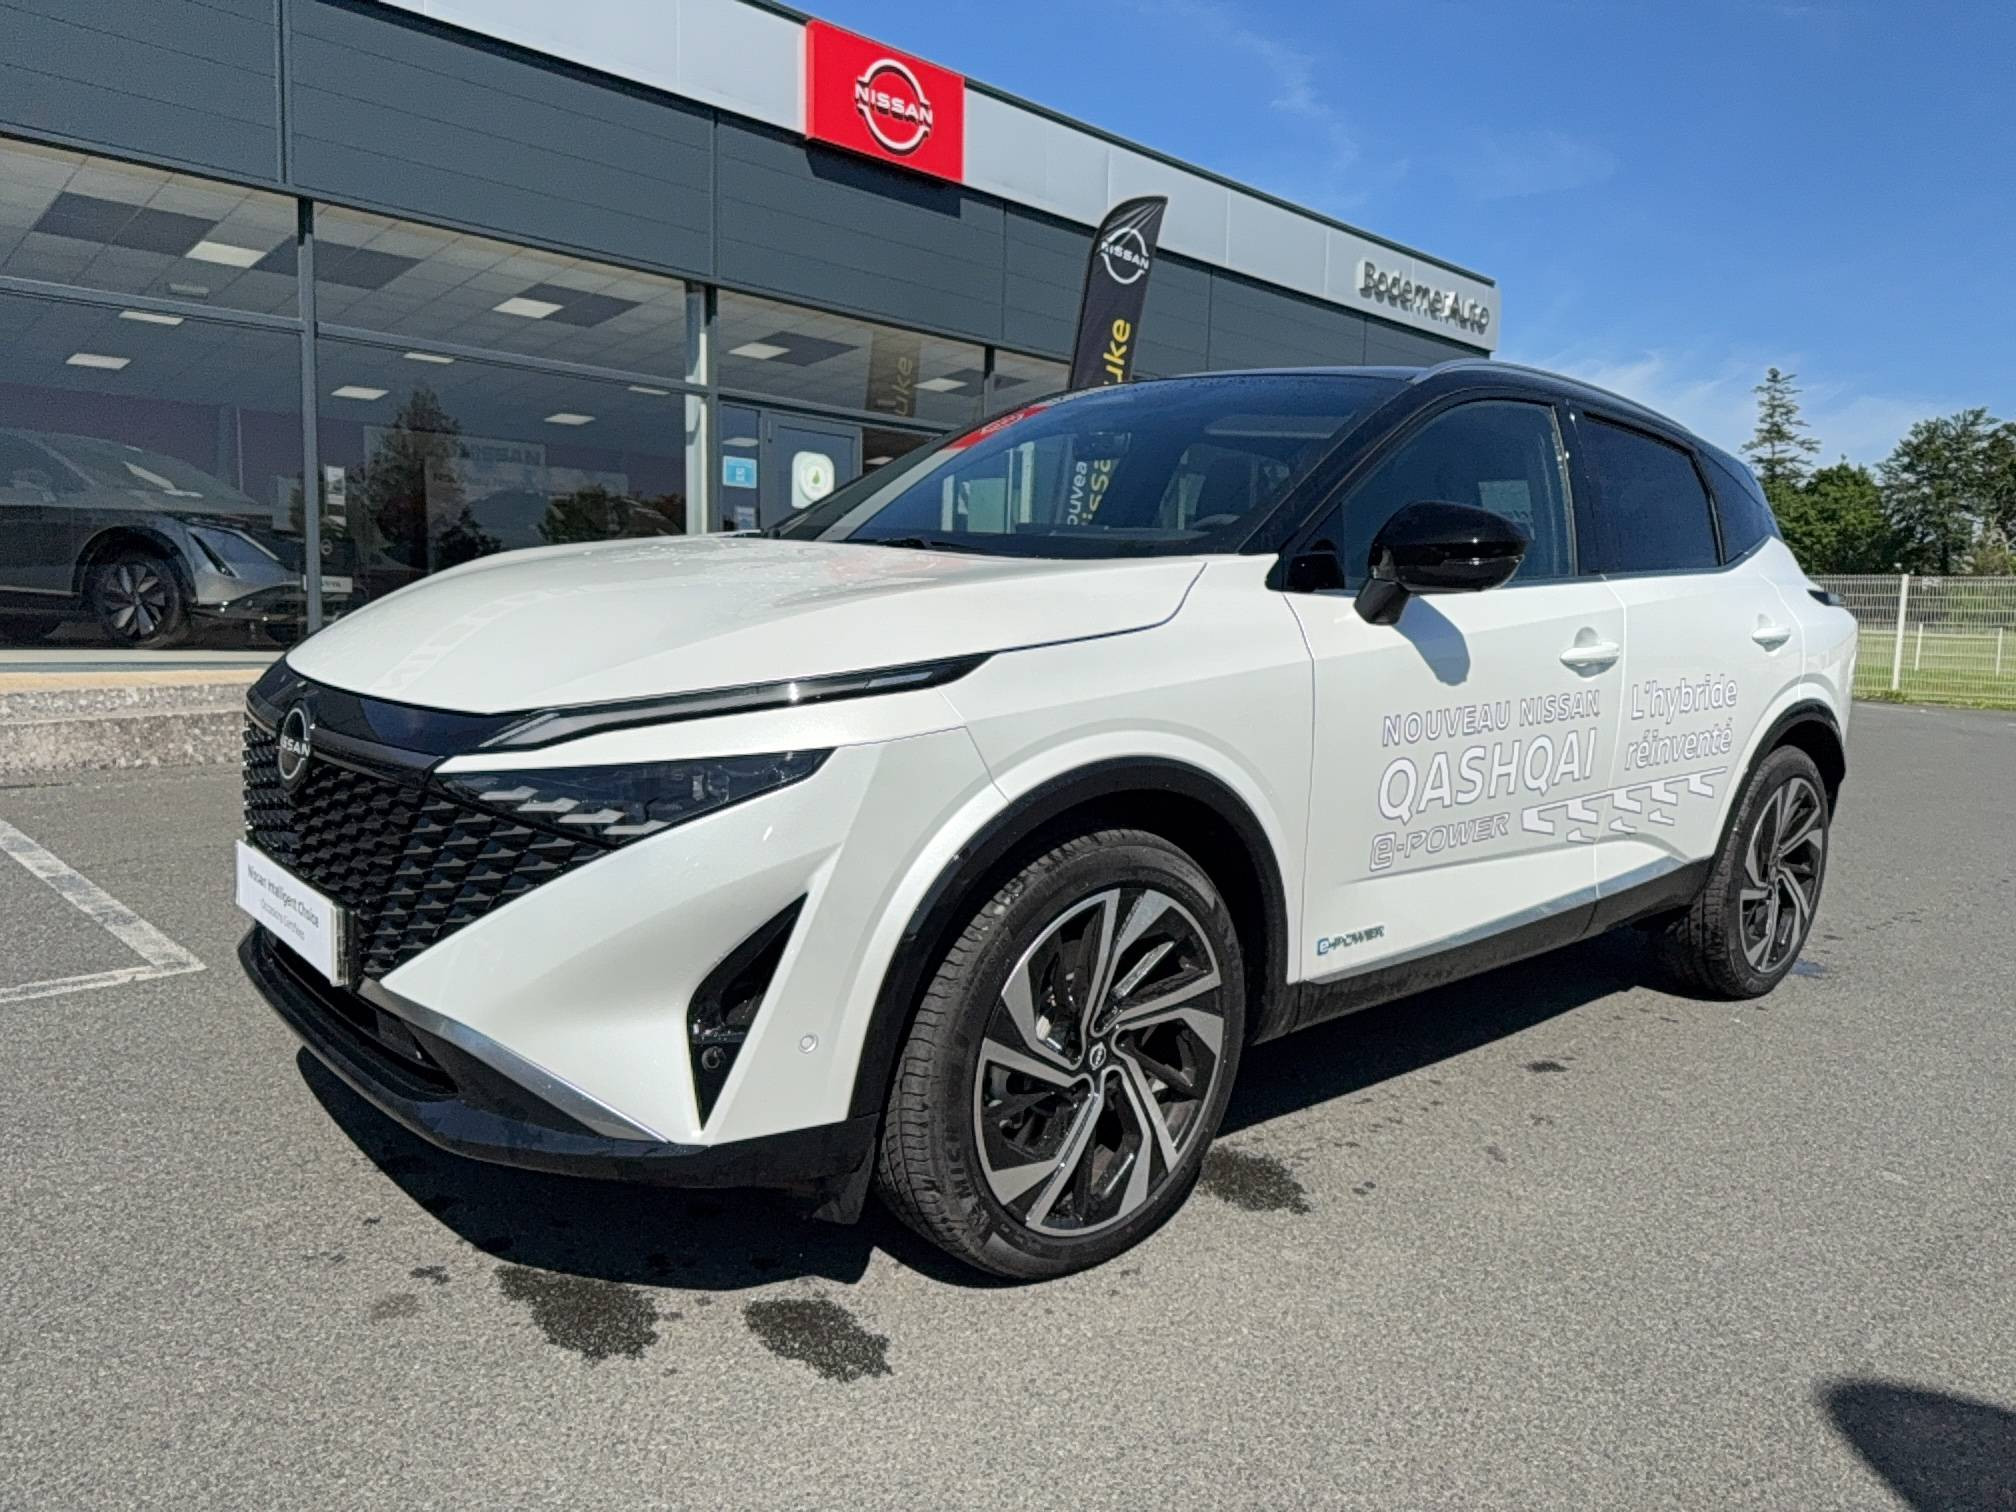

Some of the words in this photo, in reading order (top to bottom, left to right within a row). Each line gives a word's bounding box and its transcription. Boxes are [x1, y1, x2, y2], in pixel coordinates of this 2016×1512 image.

[855, 83, 933, 125] NISSAN
[1100, 241, 1150, 270] NISSAN
[1102, 319, 1131, 385] uke
[1066, 461, 1088, 526] ouvea
[1382, 700, 1511, 747] NOUVEAU
[1519, 690, 1600, 726] NISSAN
[1631, 673, 1738, 725] L'hybride
[1624, 717, 1733, 771] réinventé
[1378, 727, 1597, 826] QASHQAI
[1369, 812, 1511, 872] e-POWER
[1317, 925, 1384, 956] e-POWER
